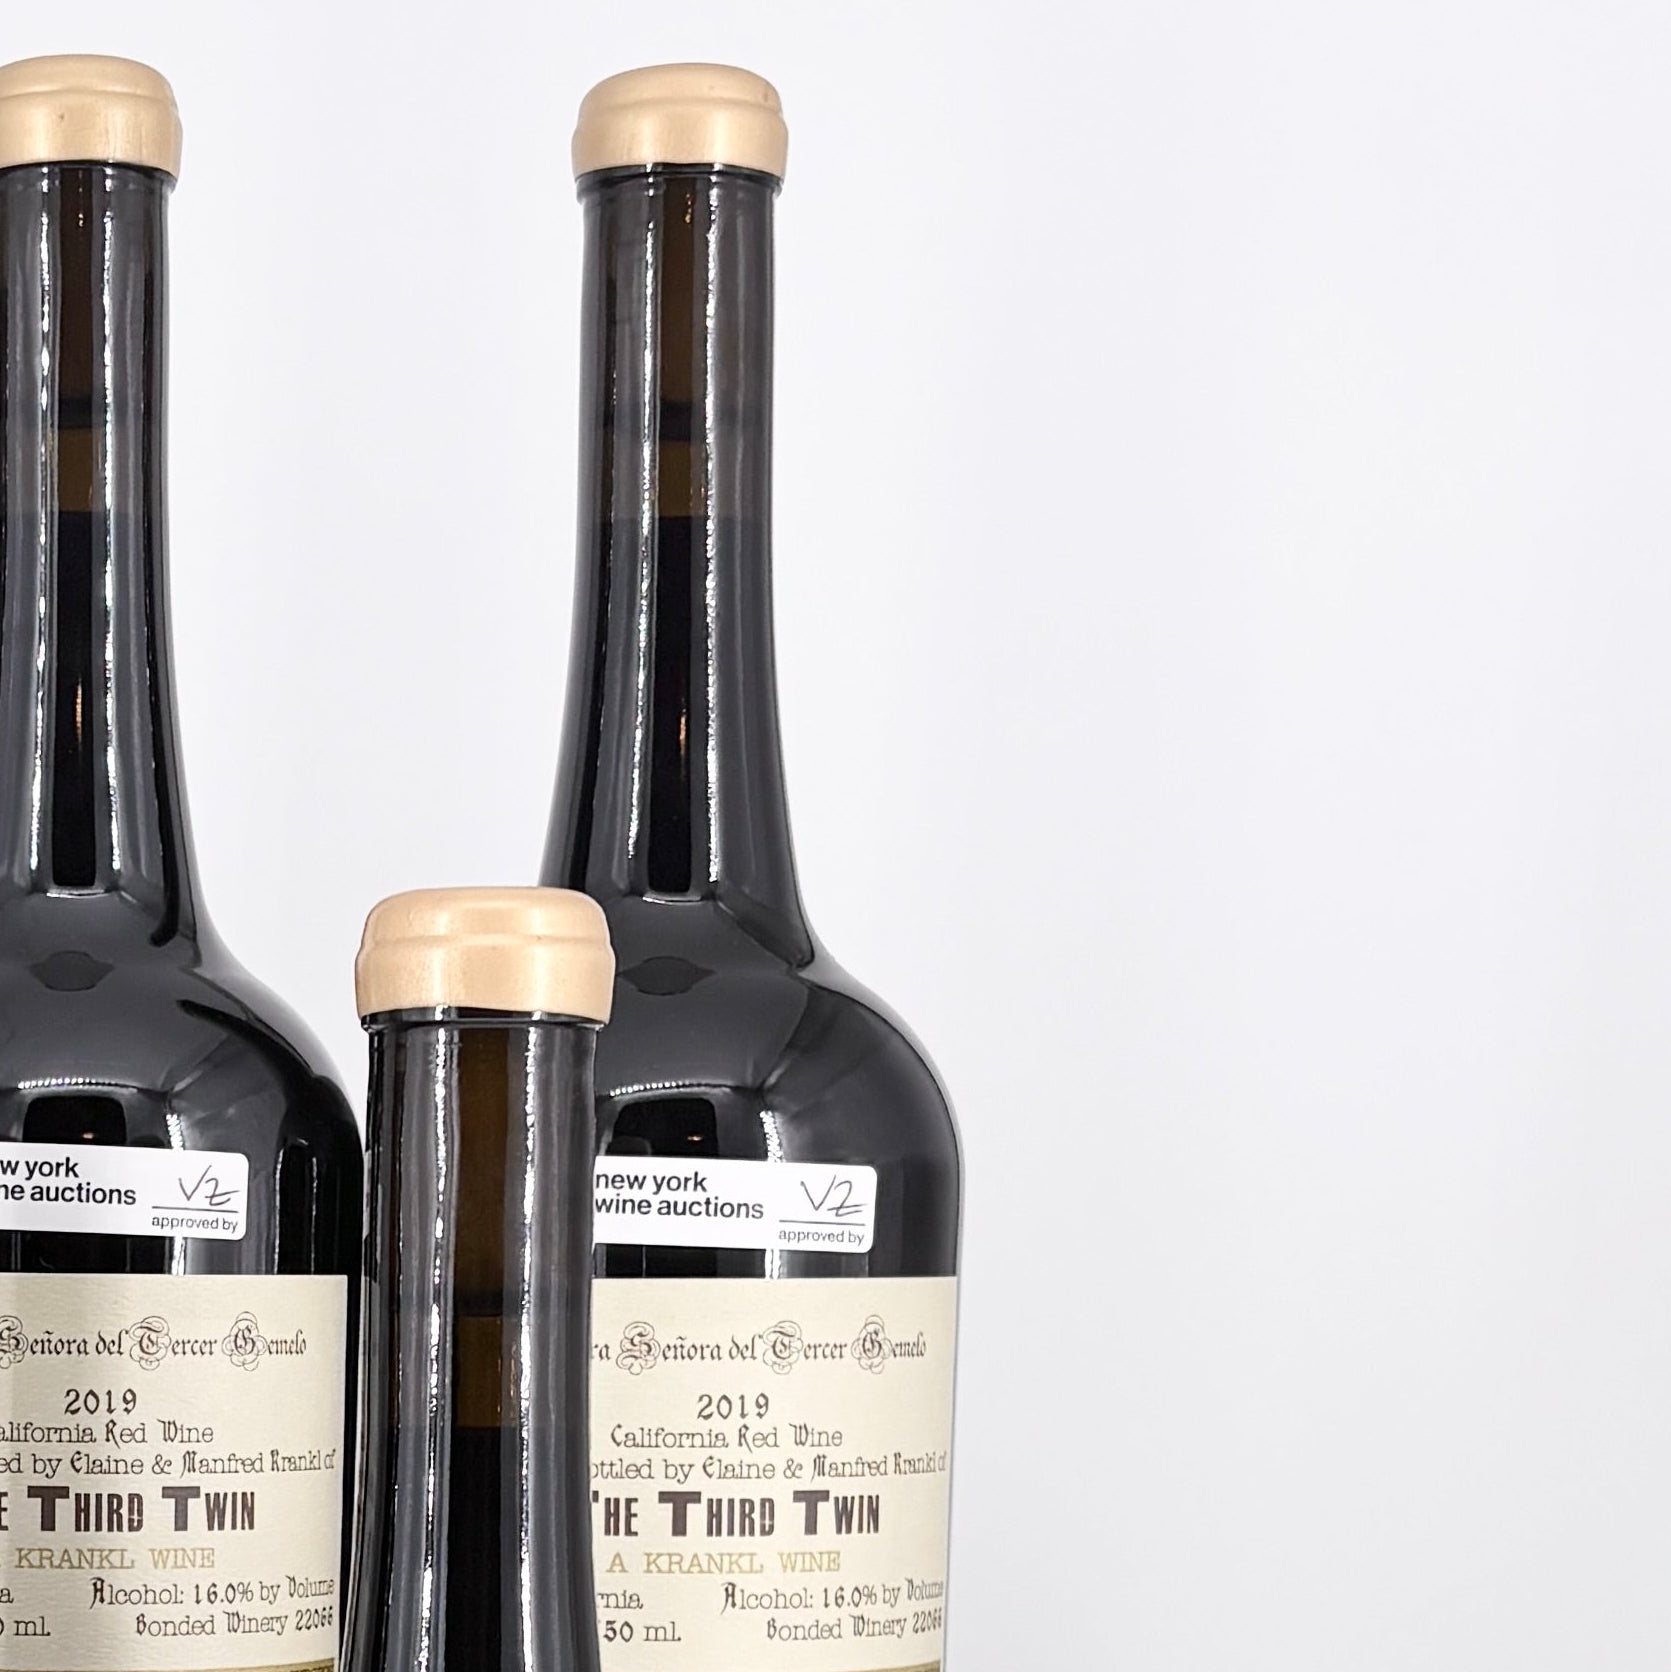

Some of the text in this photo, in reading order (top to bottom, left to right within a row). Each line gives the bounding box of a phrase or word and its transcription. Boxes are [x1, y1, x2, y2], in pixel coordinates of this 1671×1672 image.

[24, 1156, 79, 1181] york
[30, 1181, 136, 1205] auctions
[595, 1171, 707, 1195] new york
[595, 1193, 763, 1219] wine auctions
[152, 1217, 238, 1234] approved by
[779, 1230, 864, 1246] approved by
[95, 1329, 127, 1357] del
[128, 1315, 217, 1370] Tercer
[616, 1321, 722, 1375] Señora
[729, 1334, 765, 1361] del
[763, 1321, 847, 1374] Tercer
[64, 1388, 136, 1416] 2019
[697, 1392, 769, 1420] 2019
[104, 1418, 148, 1449] Red
[157, 1419, 213, 1443] Wine
[611, 1423, 842, 1453] California Red Wine
[27, 1485, 143, 1532] THIRD
[161, 1486, 255, 1532] TWIN
[593, 1490, 879, 1537] HE THIRD TWIN
[14, 1547, 135, 1569] KRANKL
[148, 1548, 214, 1569] WINE
[606, 1551, 840, 1574] A KRANKL WINE
